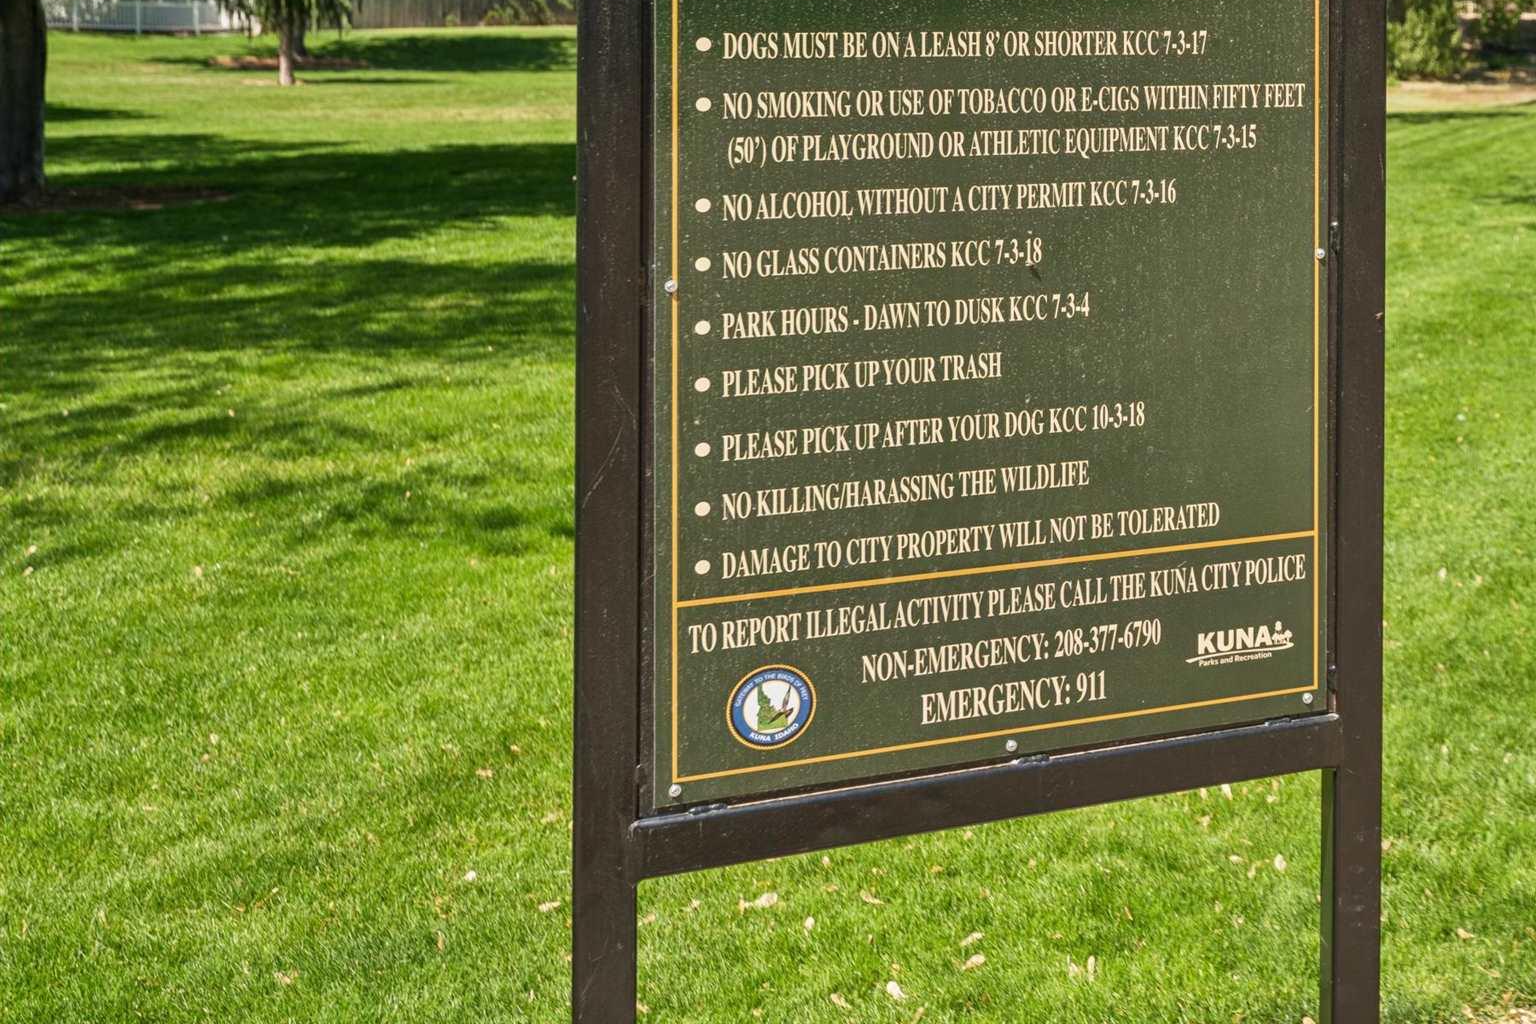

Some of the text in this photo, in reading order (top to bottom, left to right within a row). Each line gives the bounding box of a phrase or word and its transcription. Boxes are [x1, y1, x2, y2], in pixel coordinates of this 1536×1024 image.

[723, 31, 778, 59] DOGS
[783, 31, 838, 59] MUST
[843, 31, 867, 58] BE
[872, 31, 901, 58] ON
[903, 32, 917, 58] A
[920, 31, 981, 58] LEASH
[1003, 31, 1030, 57] OR
[1034, 31, 1118, 57] SHORTER
[1122, 29, 1159, 56] KCC
[1163, 30, 1208, 55] 7-3-17
[723, 83, 1305, 119] NO SMOKING OR USE OF TOBACCO OR E-CIGS WITHIN FIFTY FEET
[771, 134, 799, 163] OF
[802, 132, 935, 163] PLAYGROUND
[938, 131, 965, 158] OR
[969, 128, 1061, 157] ATHLETIC
[1065, 125, 1169, 159] EQUIPMENT
[1173, 125, 1210, 151] KCC
[1213, 124, 1257, 150] 7-3-15
[722, 193, 752, 222] NO
[856, 186, 948, 216] WITHOUT
[952, 186, 965, 212] A
[967, 184, 1012, 212] CITY
[1016, 181, 1086, 210] PERMIT
[1090, 180, 1128, 207] KCC
[1131, 178, 1177, 205] 7-3-16
[722, 237, 1043, 279] NO GLASS CONTAINERS KCC 7-3-18
[722, 310, 776, 340] PARK
[780, 306, 849, 337] HOURS
[864, 301, 920, 331] DAWN
[924, 299, 951, 327] TO
[955, 296, 1005, 326] DUSK
[1009, 294, 1048, 322] KCC
[1051, 291, 1090, 319] 7-3-4
[722, 351, 1003, 398] PLEASE PICK UP YOUR TRASH
[722, 400, 1146, 462] PLEASE PICK UP AFTER YOUR DOG KCC 10-3-18
[722, 459, 1090, 521] NO KILLING/HARASSING THE WILDLIFE
[721, 501, 1221, 580] DAMAGE TO CITY PROPERTY WILL NOT BE TOLERATED
[688, 553, 1307, 655] TO REPORT ILLEGAL ACTIVITY PLEASE CALL THE KUNA CITY POLICE
[861, 618, 1163, 684] NON-EMERGENCY: 208-377-6790
[1198, 625, 1273, 655] KUNA
[1198, 652, 1273, 668] Parks and Recreation
[920, 670, 1108, 726] EMERGENCY: 911
[748, 722, 799, 742] KUNA IDAHO
